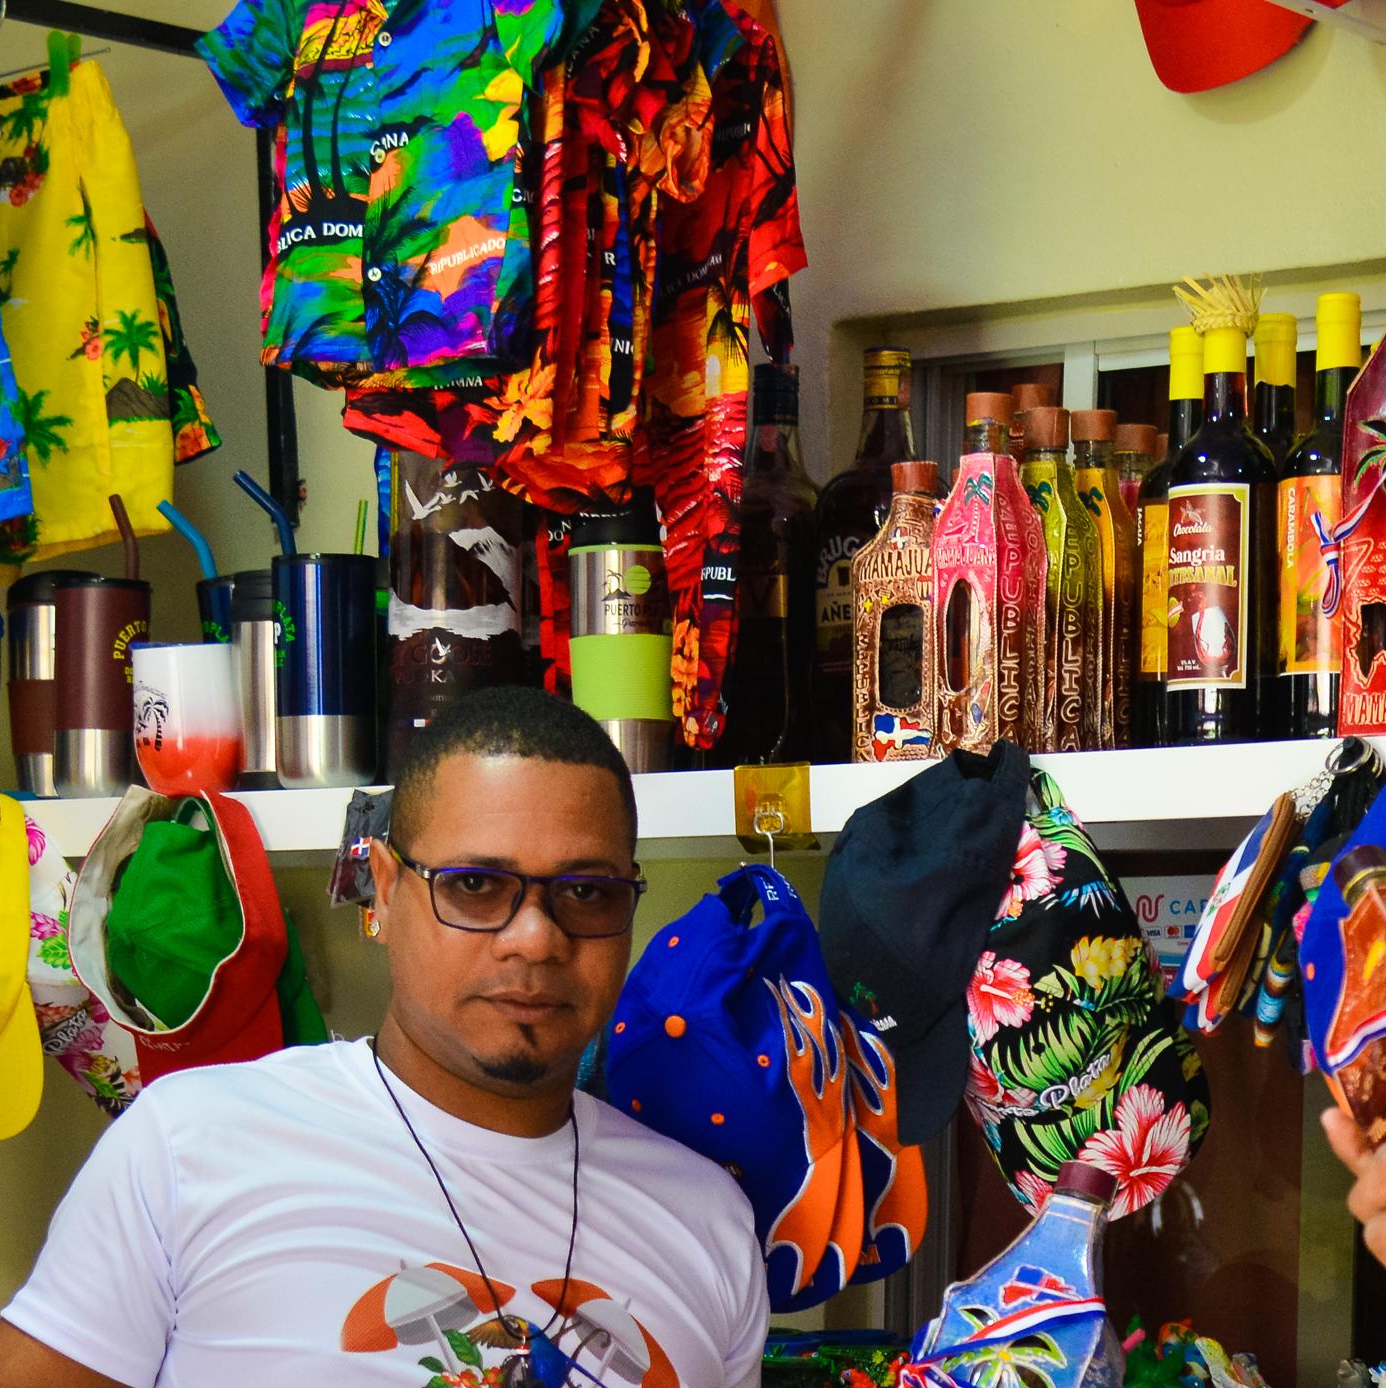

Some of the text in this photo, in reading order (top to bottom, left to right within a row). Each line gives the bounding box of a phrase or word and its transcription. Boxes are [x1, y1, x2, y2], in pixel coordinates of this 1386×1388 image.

[1286, 487, 1296, 569] CARAMBOLA
[604, 603, 641, 618] PUERTO
[1039, 1053, 1111, 1110] Plata
